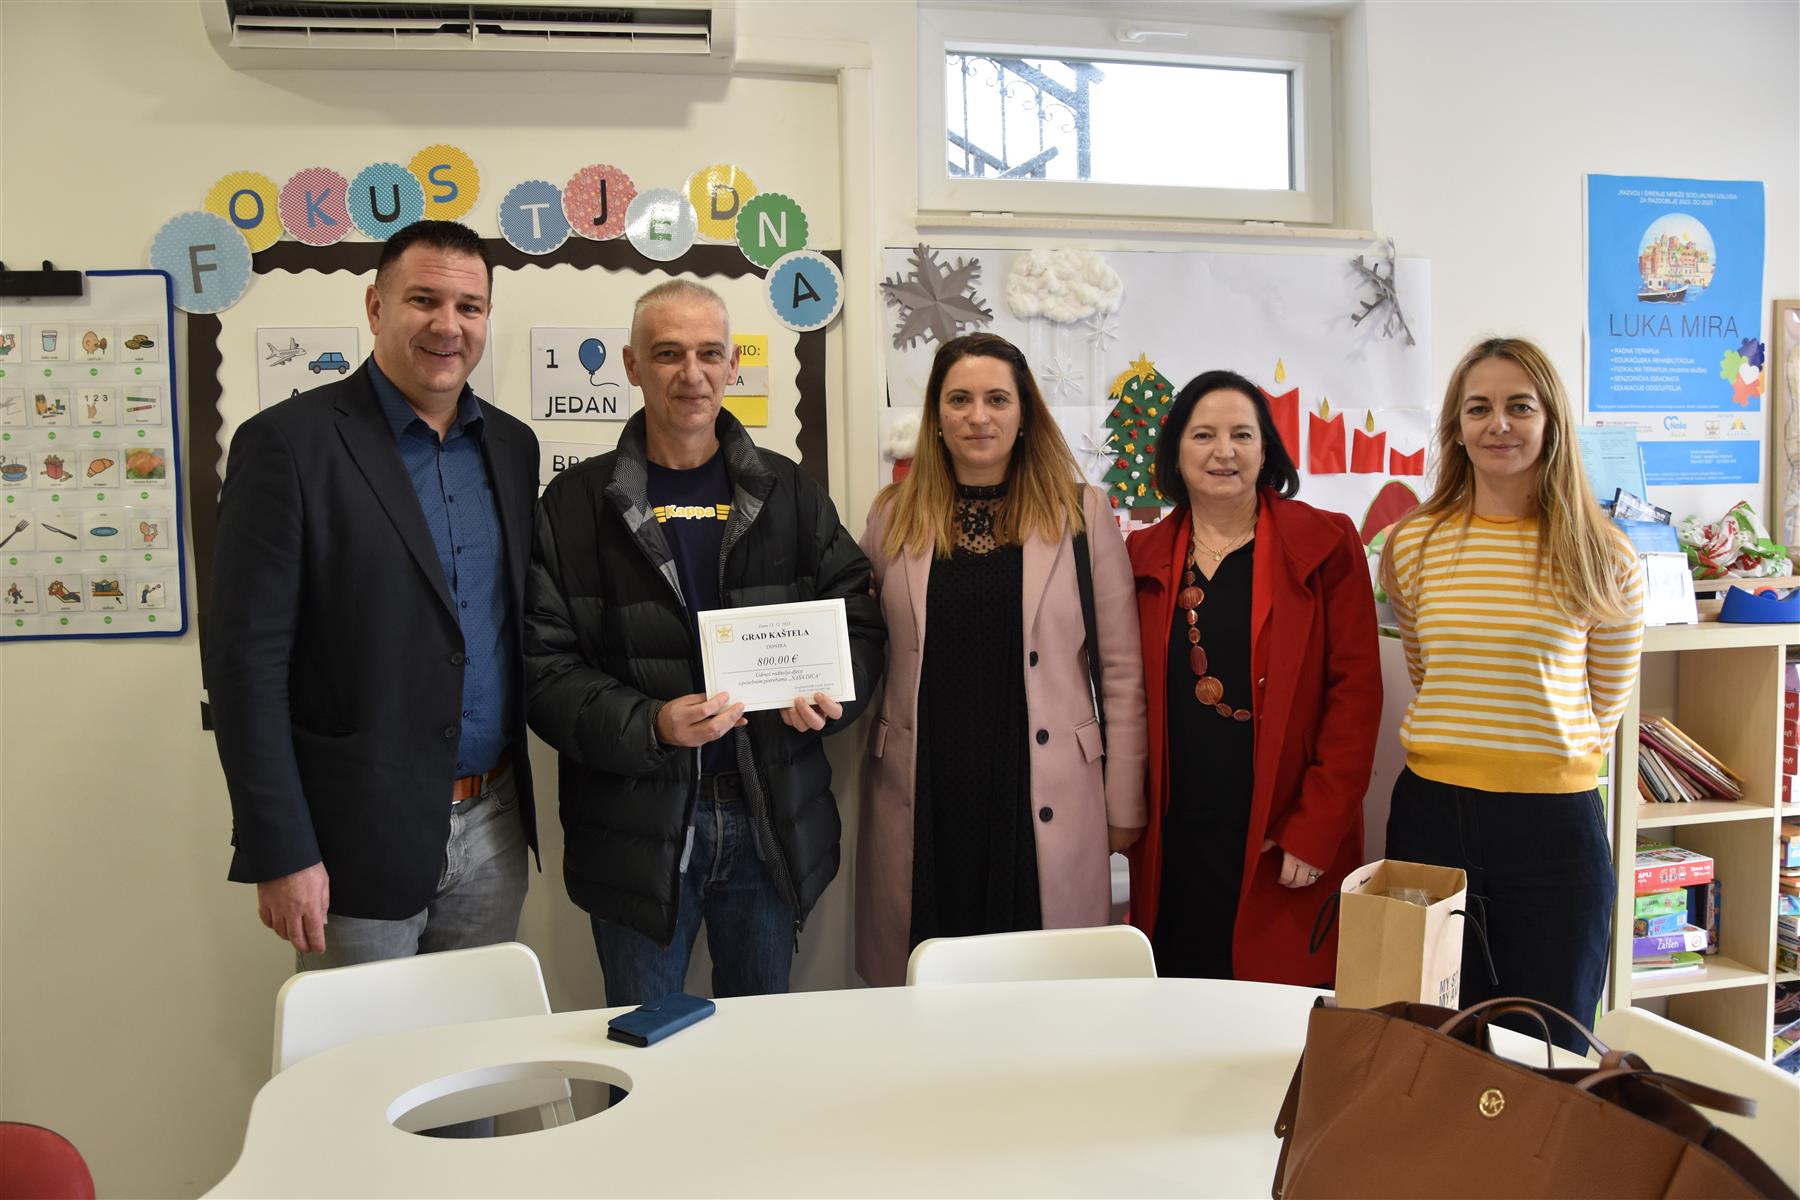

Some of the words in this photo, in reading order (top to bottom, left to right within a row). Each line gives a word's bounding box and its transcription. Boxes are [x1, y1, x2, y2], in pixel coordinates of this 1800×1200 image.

[1609, 313, 1673, 337] LUKA
[1682, 314, 1739, 338] MIRA
[1614, 347, 1634, 355] RADNA
[546, 349, 559, 369] 1
[1652, 357, 1695, 365] REHABILITACIJA
[1614, 366, 1643, 374] FIZIKALNA
[1643, 366, 1668, 374] TERAPIJA
[1614, 374, 1650, 382] SENZORIČKA
[1650, 375, 1680, 383] IGRAONICA
[1614, 384, 1645, 392] EDUKACIJE
[1645, 384, 1682, 392] ODGOJITELJA
[545, 395, 617, 418] JEDAN
[665, 504, 716, 520] Kappa
[741, 632, 767, 641] GRAD
[768, 628, 809, 640] KAŠTELA
[757, 654, 790, 666] 800,00
[791, 653, 799, 663] €
[1657, 938, 1679, 951] Zahlen
